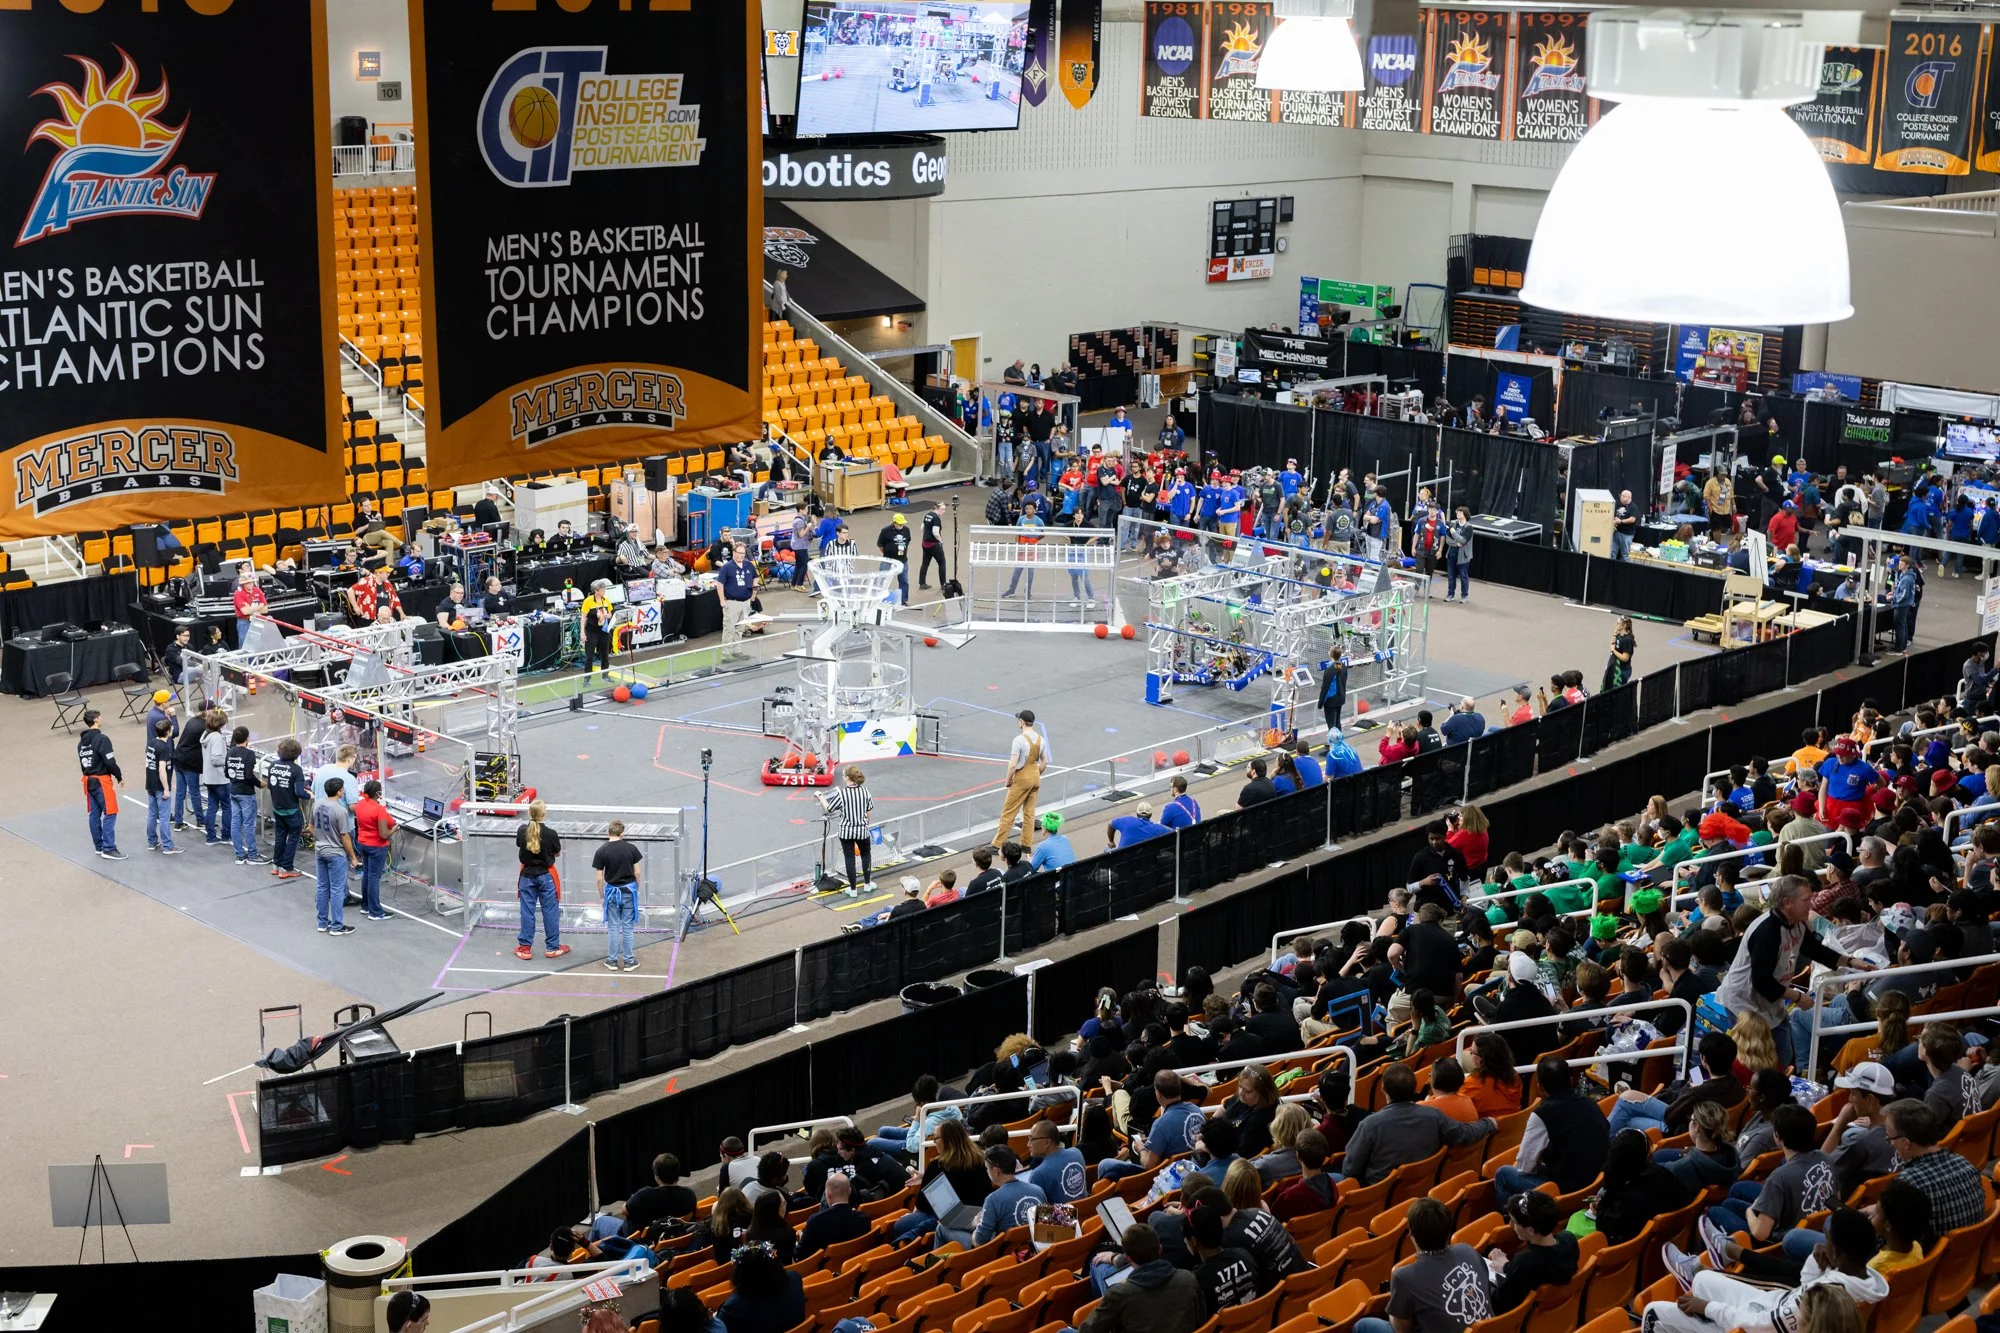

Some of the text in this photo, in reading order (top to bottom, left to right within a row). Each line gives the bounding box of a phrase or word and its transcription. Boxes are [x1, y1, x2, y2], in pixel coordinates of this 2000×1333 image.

[1149, 2, 1201, 16] 1981
[1216, 3, 1272, 17] 1981
[1440, 11, 1503, 28] 1991
[1904, 33, 1963, 57] 2016
[1157, 44, 1194, 62] NCAA
[1372, 53, 1415, 71] NCAA
[1160, 76, 1185, 88] MEN'S
[1227, 78, 1254, 90] MEN'S
[382, 88, 399, 98] 101
[579, 78, 680, 102] COLLEGE
[1146, 86, 1199, 99] BASKETBALL
[1211, 88, 1271, 101] BASKETBALL
[1375, 87, 1405, 98] MEN'S
[1152, 97, 1191, 108] MIDWEST
[1209, 98, 1272, 111] TOURNAMENT
[1282, 91, 1343, 105] BASKETBALL
[1359, 97, 1421, 111] BASKETBALL
[1442, 94, 1493, 110] WOMEN'S
[1279, 102, 1345, 116] TOURNAMENT
[1526, 98, 1579, 113] WOMEN'S
[1825, 106, 1864, 116] BASKETBALL
[1150, 107, 1193, 119] REGIONAL
[1212, 109, 1267, 122] CHAMPIONS
[1283, 113, 1339, 126] CHAMPIONS
[1366, 109, 1412, 121] MIDWEST
[1433, 106, 1501, 125] BASKETBALL
[1517, 111, 1588, 127] BASKETBALL
[1795, 112, 1857, 125] INVITATIONAL
[1896, 113, 1958, 124] COLLEGE INSIDER
[1362, 119, 1414, 132] REGIONAL
[1433, 120, 1497, 137] CHAMPIONS
[1903, 123, 1950, 132] POSTSEASON
[573, 124, 696, 146] POSTSEASON
[1901, 131, 1950, 141] TOURNAMENT
[572, 143, 703, 167] TOURNAMENT
[23, 169, 216, 240] ATLANTIC SUN
[486, 222, 705, 263] MEN'S BASKETBALL
[0, 258, 265, 302] EN'S BASKETBALL
[485, 252, 704, 302] TOURNAMENT
[1251, 268, 1272, 278] BEARS
[184, 292, 262, 334] SUN
[486, 288, 705, 340] CHAMPIONS
[1283, 339, 1306, 350] THE
[1258, 349, 1329, 365] MECHANISMS
[1829, 373, 1844, 382] Flying
[1844, 375, 1862, 383] Legion
[511, 370, 686, 437] MERCER
[546, 411, 658, 437] BEARS
[1846, 413, 1891, 426] TEAM 4189
[16, 427, 239, 506] MERCER
[59, 475, 202, 502] BEARS
[270, 767, 292, 777] Google
[781, 774, 816, 786] 7315
[1243, 1210, 1272, 1240] 1771
[1217, 1260, 1248, 1284] 1771
